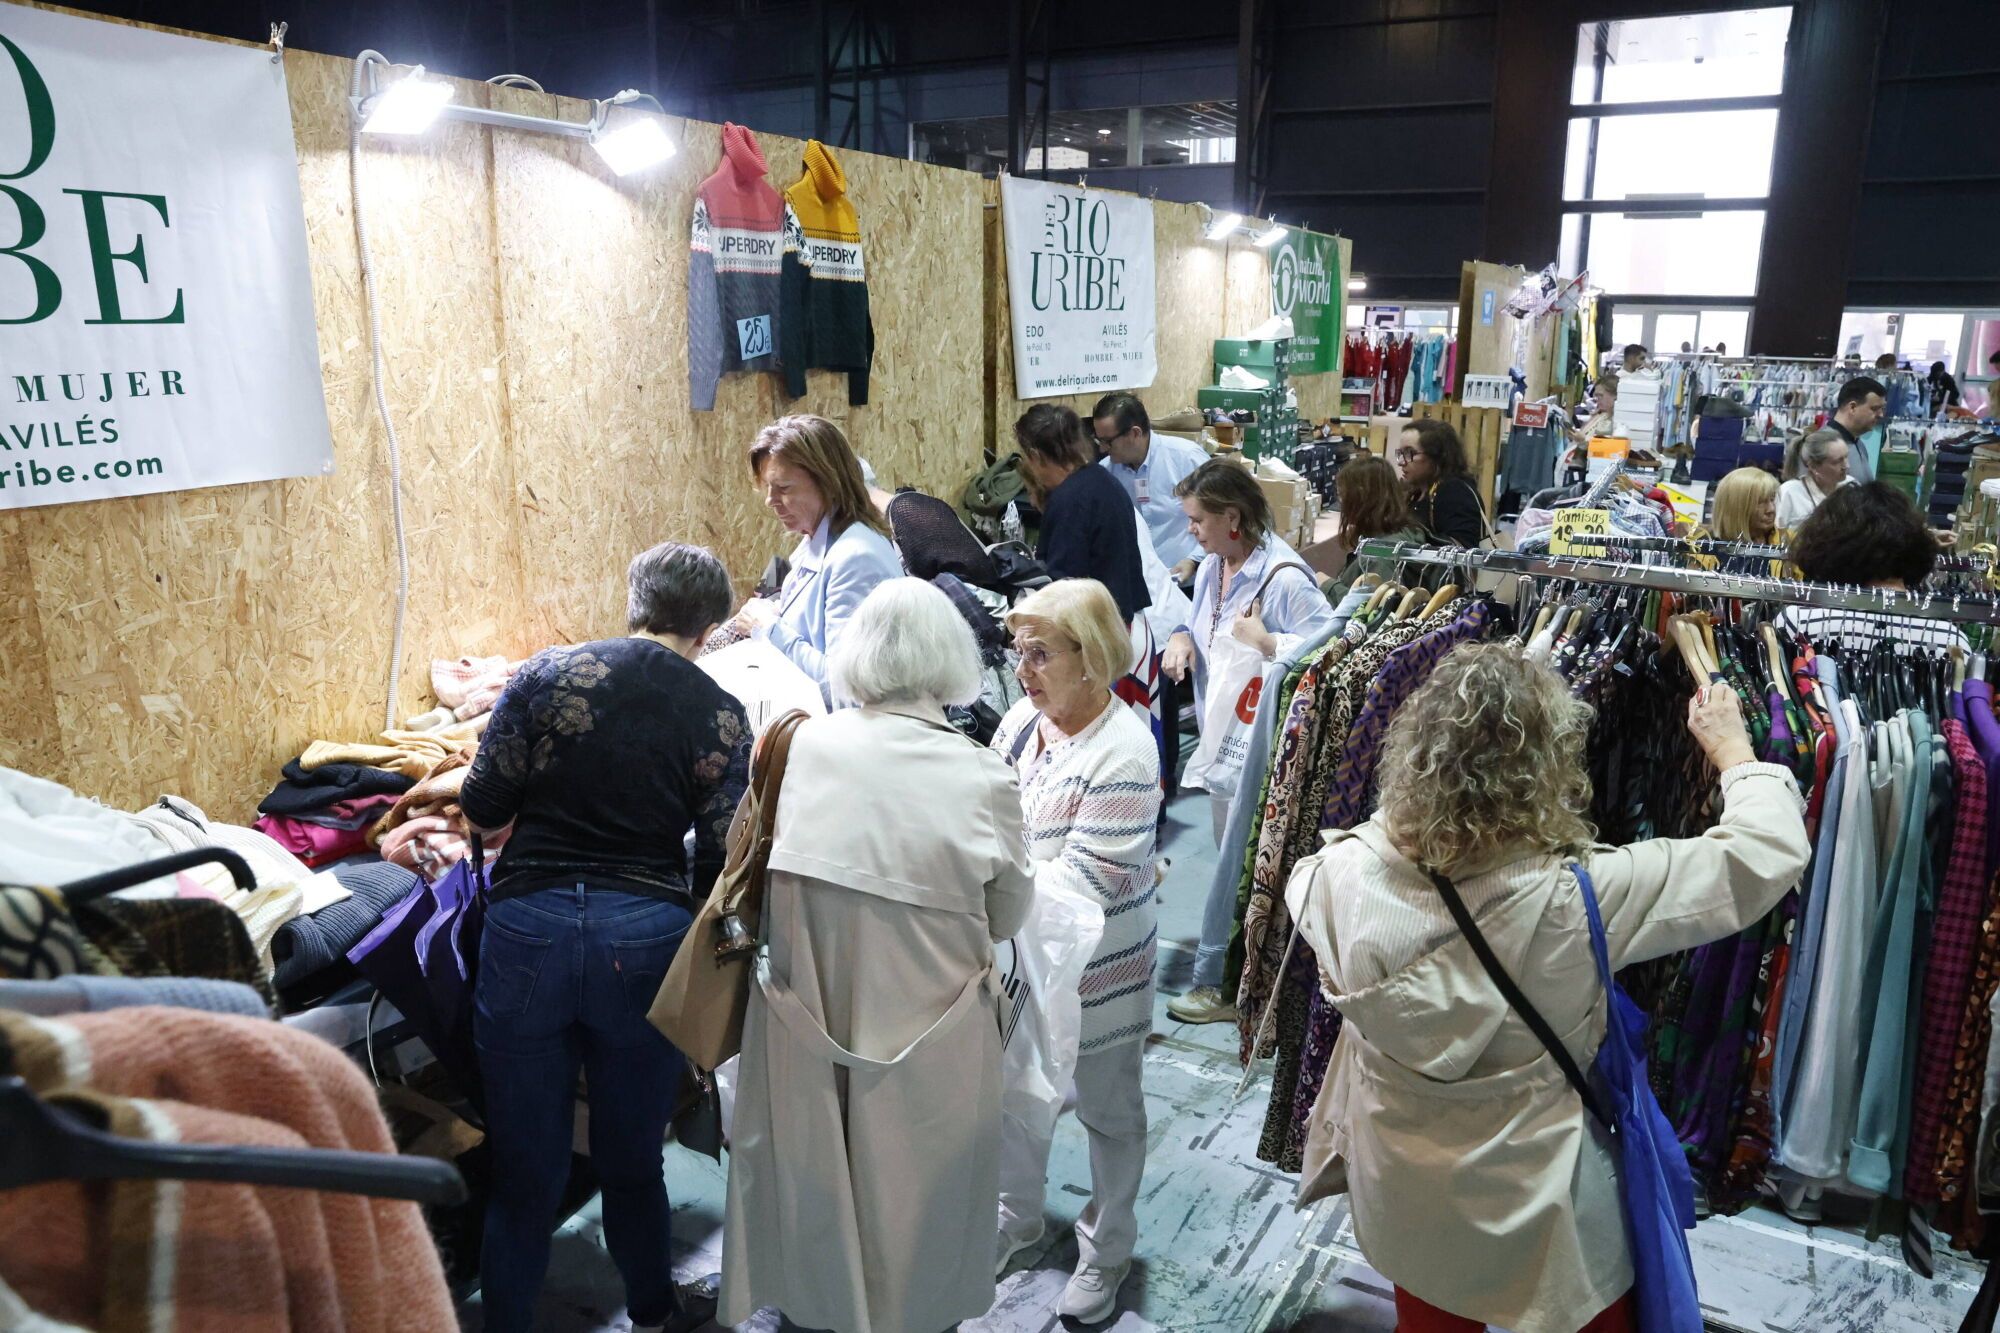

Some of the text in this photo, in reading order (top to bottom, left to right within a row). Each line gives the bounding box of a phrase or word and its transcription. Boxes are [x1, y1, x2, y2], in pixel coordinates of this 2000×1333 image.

[1044, 194, 1056, 248] DEL
[1057, 194, 1110, 256] RIO
[1030, 251, 1125, 311] URIBE
[1299, 271, 1332, 305] world
[1102, 321, 1128, 336] AVILÉS
[1084, 352, 1114, 363] HOMBRE
[12, 369, 187, 403] MUJER
[1035, 372, 1118, 389] www.delriouribe.com
[1557, 509, 1605, 525] Camisas
